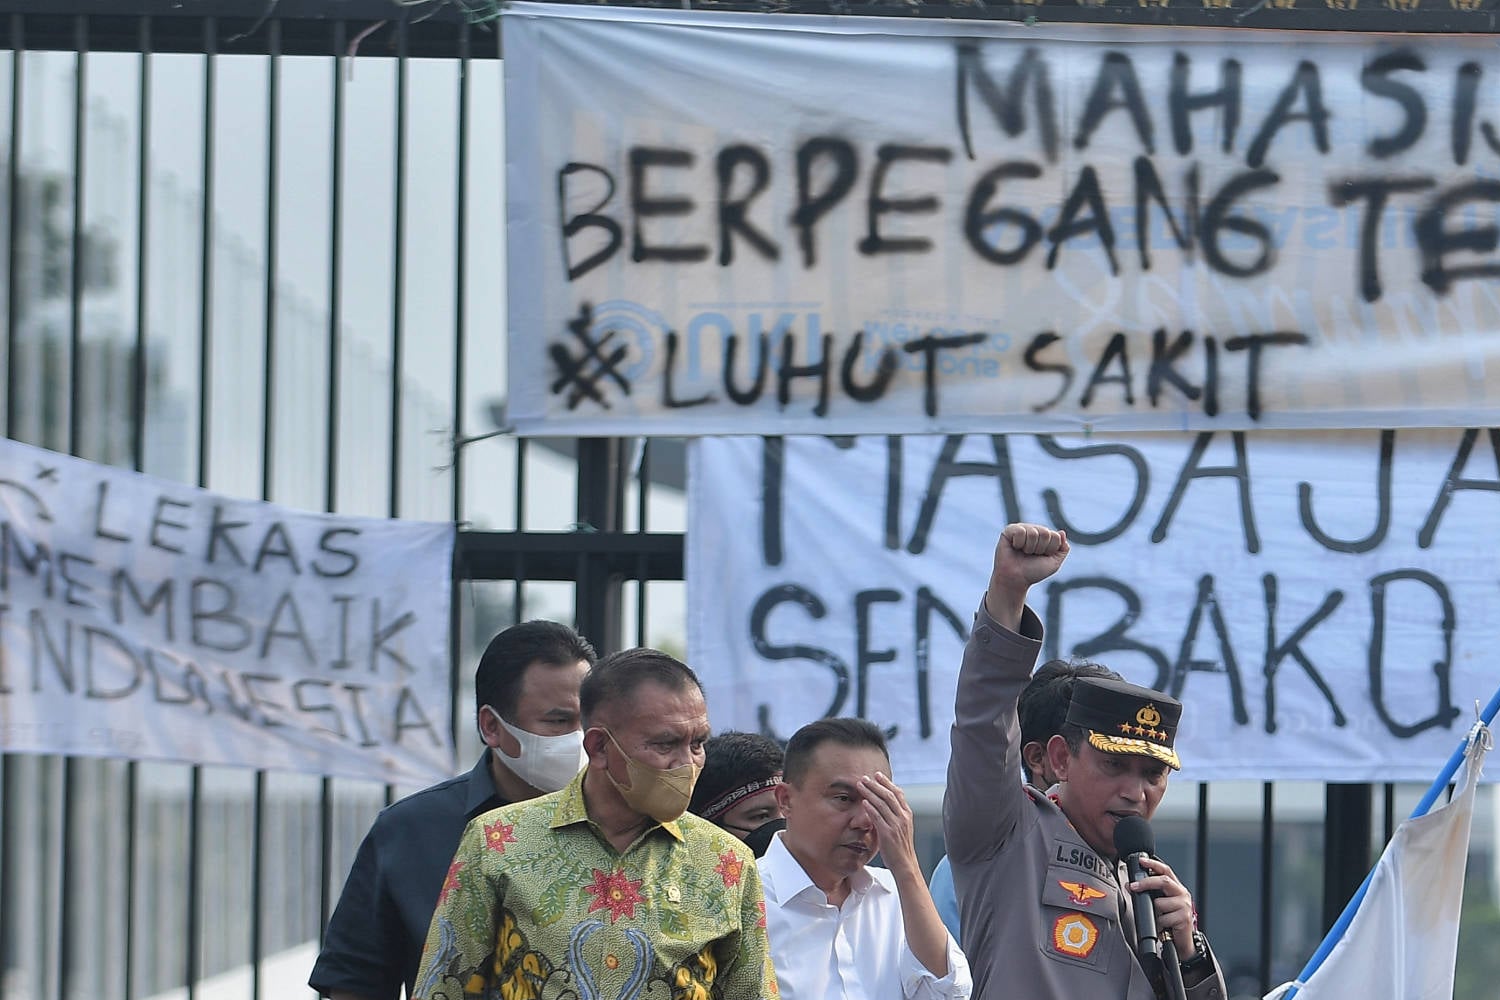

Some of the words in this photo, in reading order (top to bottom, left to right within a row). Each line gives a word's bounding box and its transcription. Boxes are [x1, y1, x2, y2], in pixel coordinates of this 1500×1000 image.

[556, 134, 1283, 281] BERPEGANG
[662, 332, 987, 417] LUHUT
[1022, 330, 1311, 422] SAKIT
[94, 480, 362, 579] LEKAS
[760, 432, 1260, 566] MASA
[0, 519, 418, 674] MEMBAIK
